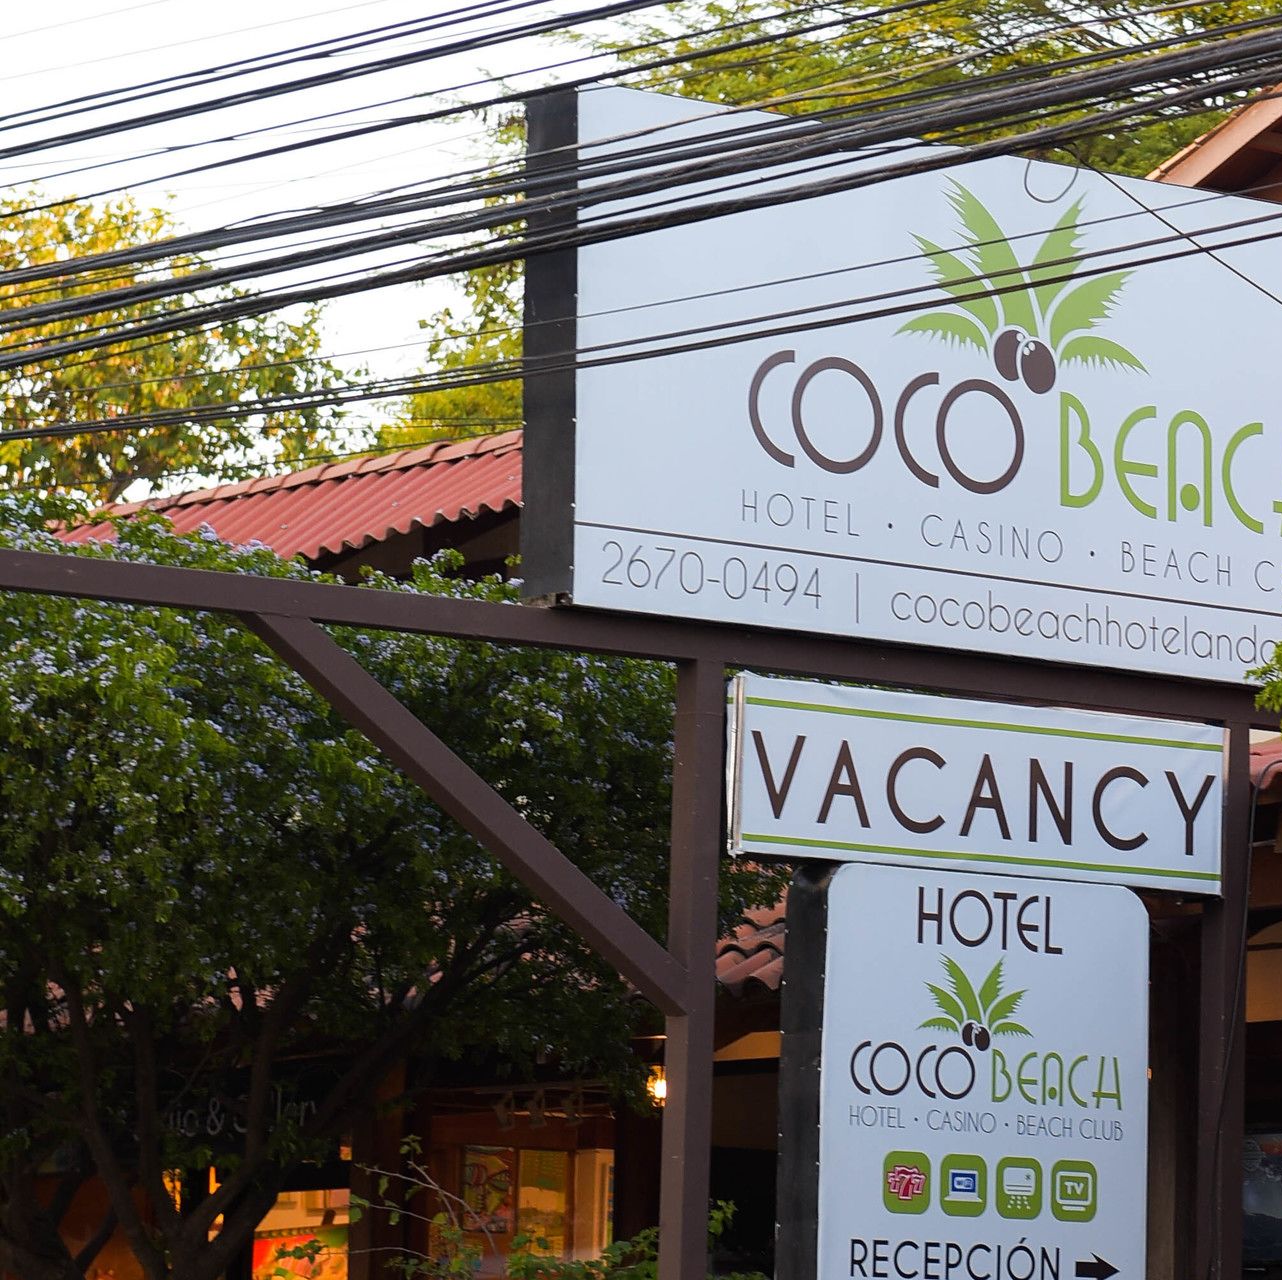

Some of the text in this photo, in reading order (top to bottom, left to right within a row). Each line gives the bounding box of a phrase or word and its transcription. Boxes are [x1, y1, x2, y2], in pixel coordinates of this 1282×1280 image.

[748, 349, 1025, 495] COCO
[742, 489, 860, 538] HOTEL
[920, 514, 1064, 563] CASINO
[1120, 539, 1231, 588] BEACH
[602, 540, 1277, 665] 2670-0494 cocobeachhotelandc
[751, 730, 1216, 856] VACANCY
[917, 885, 1064, 956] HOTEL
[850, 1040, 1123, 1111] COCO BEACH
[849, 1105, 1124, 1142] HOTEL CASINO BEACH CLUB
[1064, 1181, 1085, 1196] TV
